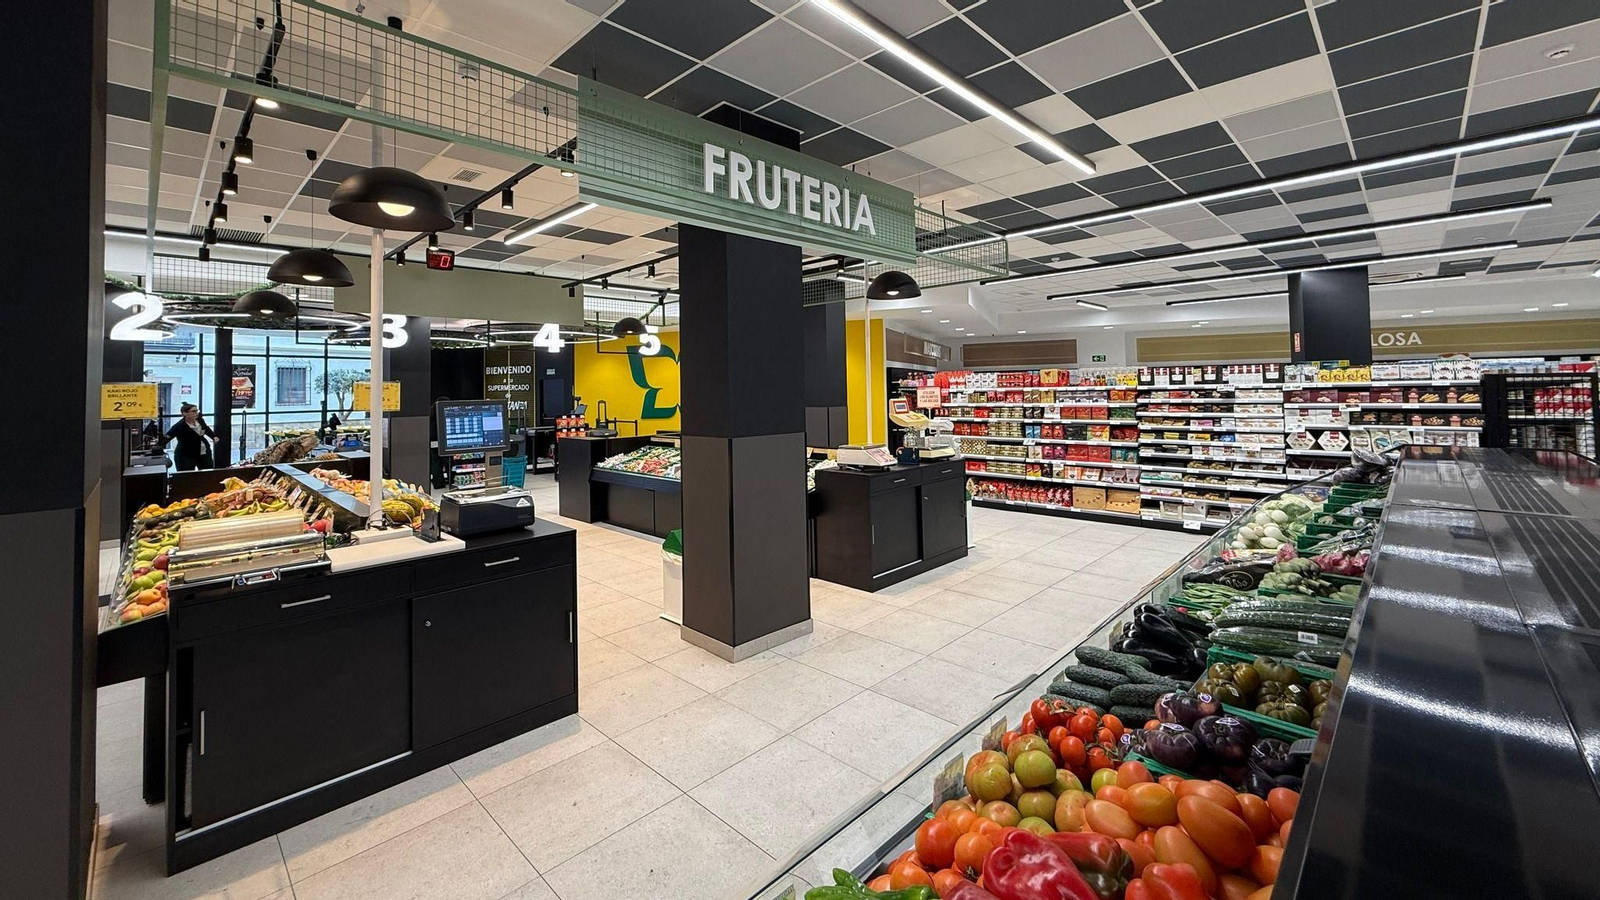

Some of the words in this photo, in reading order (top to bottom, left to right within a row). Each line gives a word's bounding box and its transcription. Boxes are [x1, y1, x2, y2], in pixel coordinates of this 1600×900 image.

[703, 142, 876, 236] FRUTERIA
[110, 291, 164, 341] 2
[533, 323, 565, 353] 4
[638, 324, 661, 356] 5
[486, 366, 531, 374] BIENVENIDO
